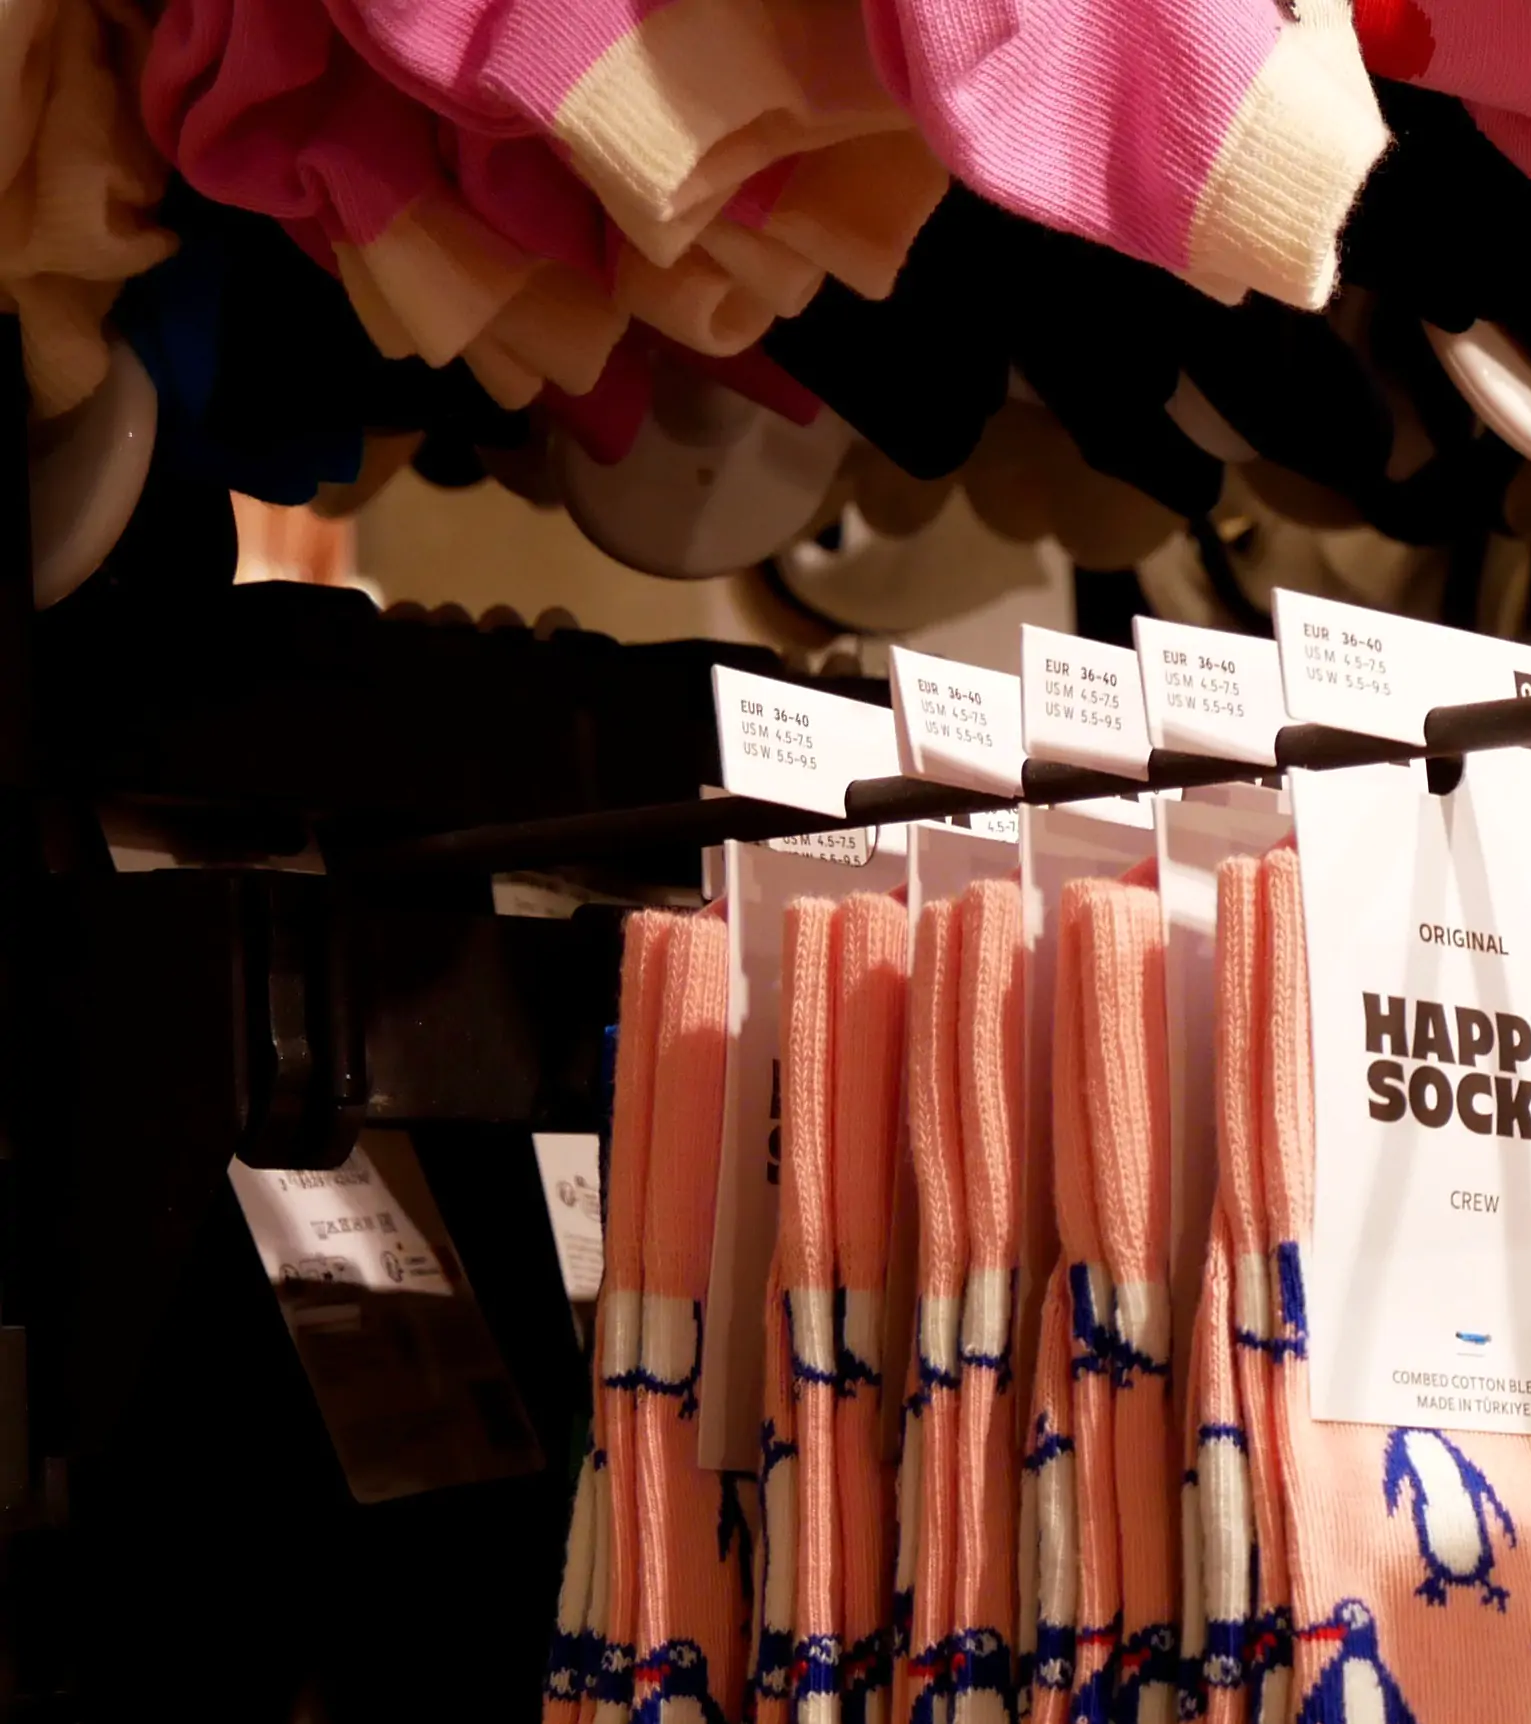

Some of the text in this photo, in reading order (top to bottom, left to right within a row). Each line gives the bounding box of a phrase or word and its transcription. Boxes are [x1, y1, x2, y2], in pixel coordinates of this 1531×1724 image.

[1303, 624, 1383, 652] EUR 36-40
[1046, 659, 1117, 687] EUR 36-40
[1163, 650, 1236, 675] EUR 36-40
[1304, 645, 1387, 674] US M 4.5-7.5
[918, 679, 982, 704] EUR 36-40
[1165, 672, 1240, 696] US M 4.5-7.5
[1307, 667, 1391, 695] US W 5.5-9.5
[1046, 681, 1120, 709] US M 4.5-7.5
[1168, 693, 1244, 717] US W 5.5-9.5
[740, 700, 810, 727] EUR 36-40
[921, 701, 988, 726] US M 4.5-7.5
[1046, 703, 1123, 730] US W 5.5-9.5
[742, 722, 814, 749] US M 4.5-7.5
[925, 720, 993, 747] US W 5.5-9.5
[743, 742, 817, 770] US W 5.5-9.5
[1419, 923, 1509, 956] ORIGINAL
[1450, 1190, 1500, 1213] CREW
[1392, 1370, 1448, 1390] COMBED
[1451, 1375, 1506, 1393] COTTON
[1417, 1395, 1453, 1412] MADE
[1455, 1397, 1472, 1413] IN
